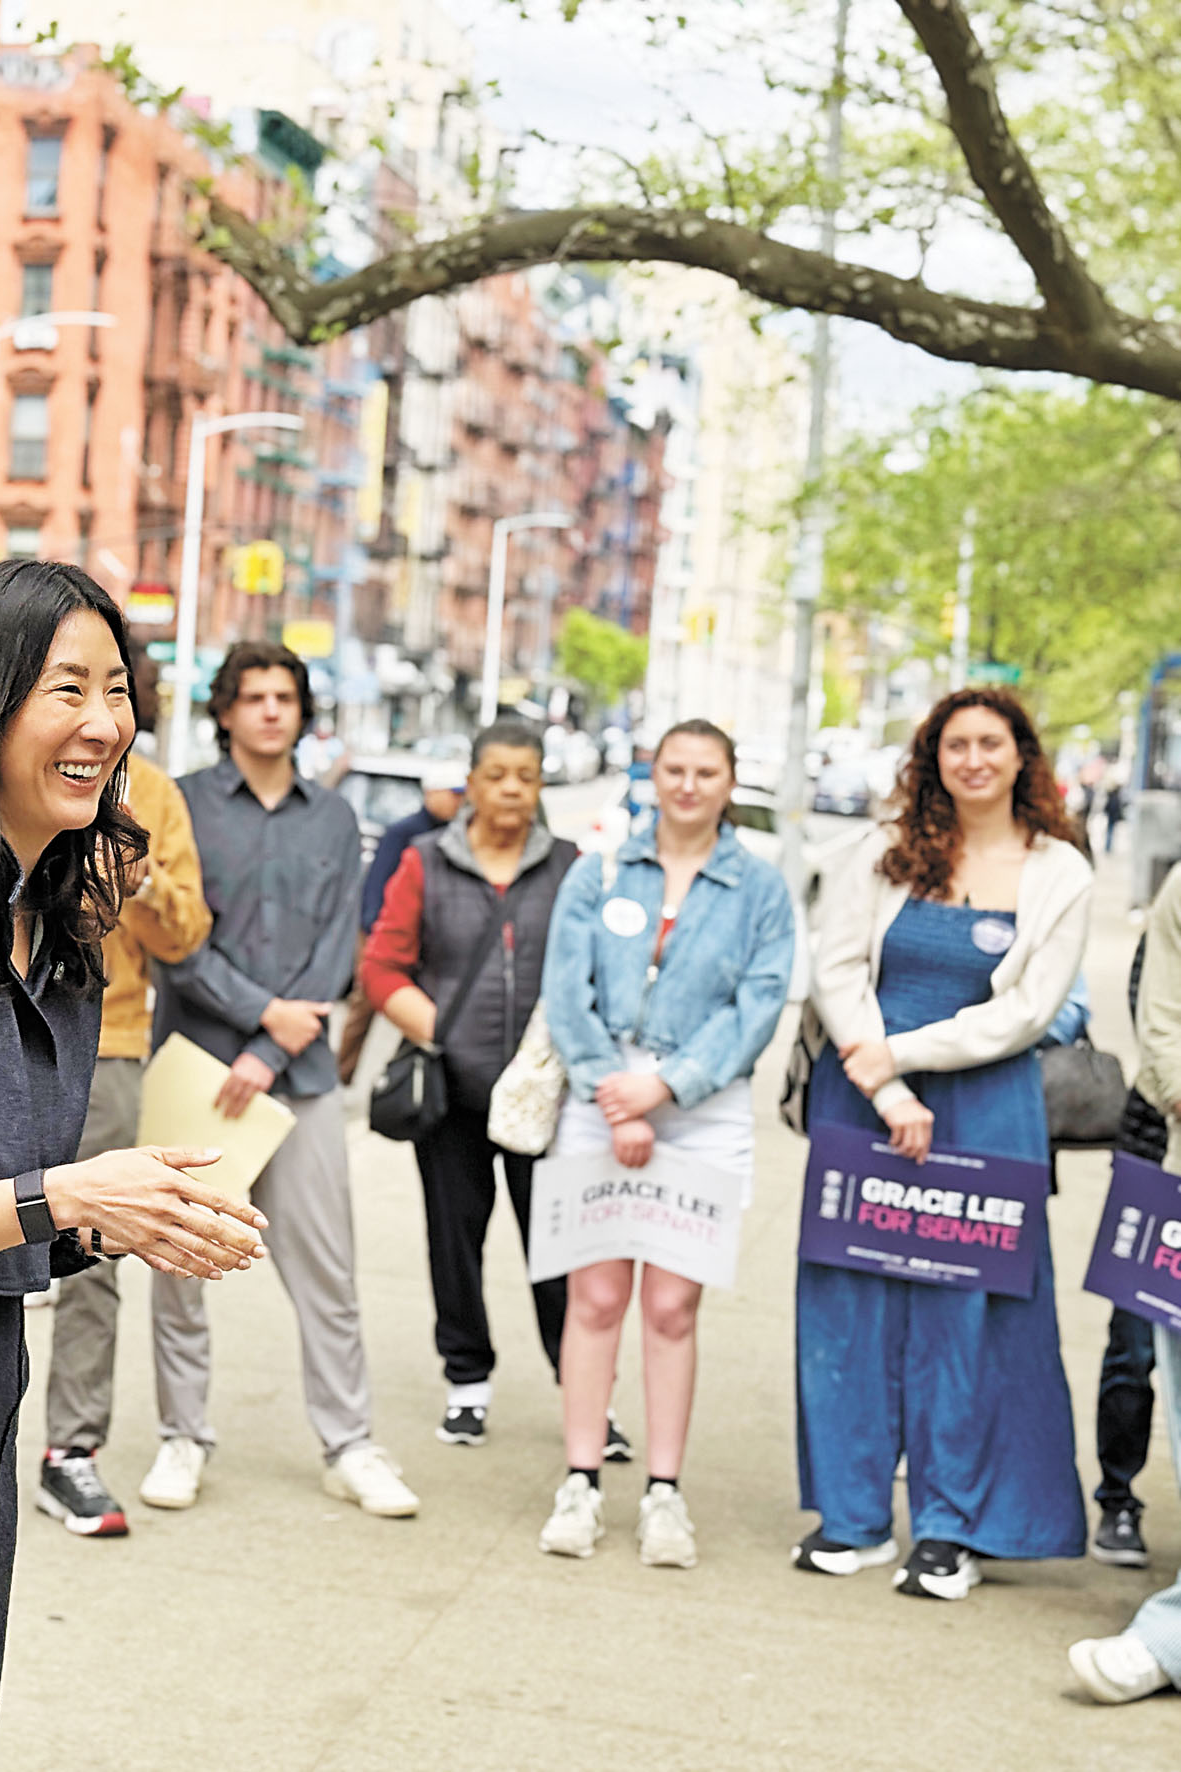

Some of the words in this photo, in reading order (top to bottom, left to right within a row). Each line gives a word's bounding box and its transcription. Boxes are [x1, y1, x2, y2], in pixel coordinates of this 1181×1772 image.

[581, 1180, 668, 1204] GRACE
[677, 1192, 721, 1219] LEE
[861, 1176, 964, 1218] GRACE
[966, 1194, 1025, 1227] LEE
[579, 1202, 624, 1229] FOR
[631, 1203, 719, 1246] SENATE
[857, 1202, 912, 1234] FOR
[915, 1213, 1020, 1251] SENATE
